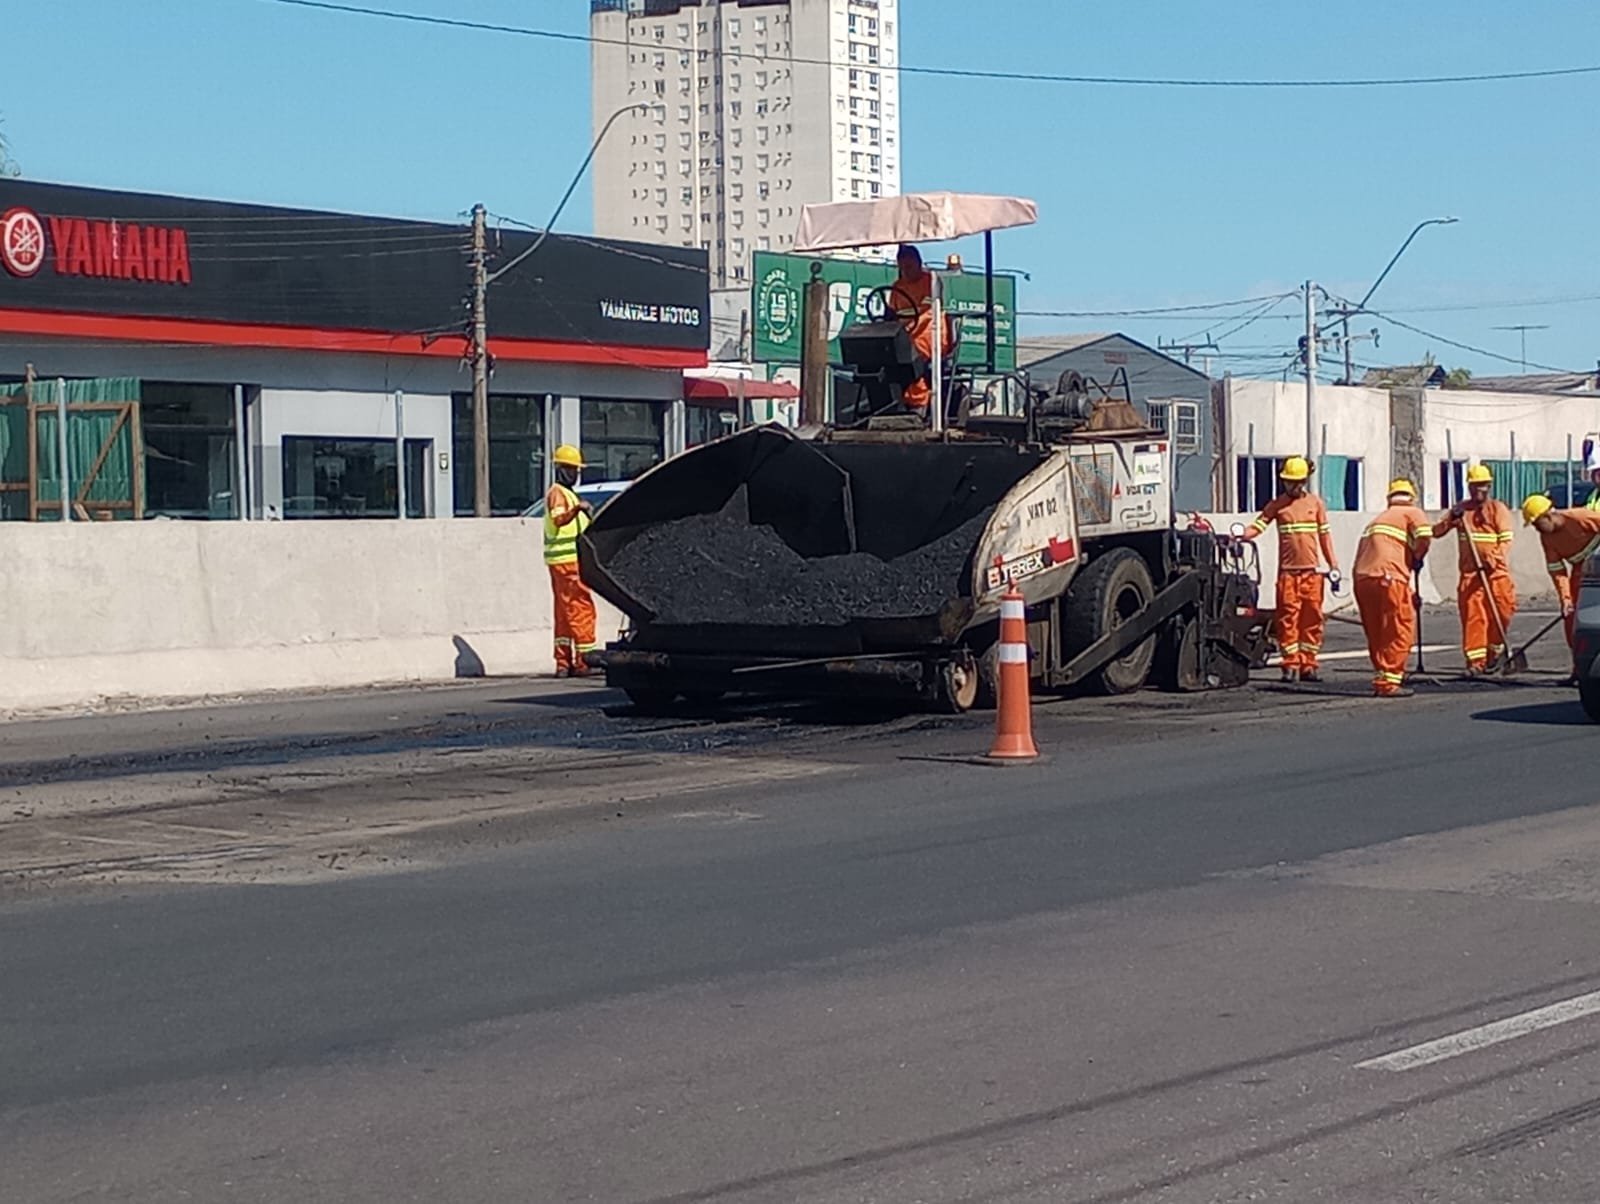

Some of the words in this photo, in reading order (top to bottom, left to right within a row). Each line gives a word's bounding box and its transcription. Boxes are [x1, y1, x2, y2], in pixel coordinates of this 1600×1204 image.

[50, 215, 191, 284] YAMAHA
[600, 299, 658, 322] YAMAVALE
[660, 305, 700, 326] MOTOS
[770, 292, 787, 308] 15
[1027, 502, 1044, 519] VAT
[1046, 497, 1057, 515] 02
[1001, 551, 1044, 584] TEREX
